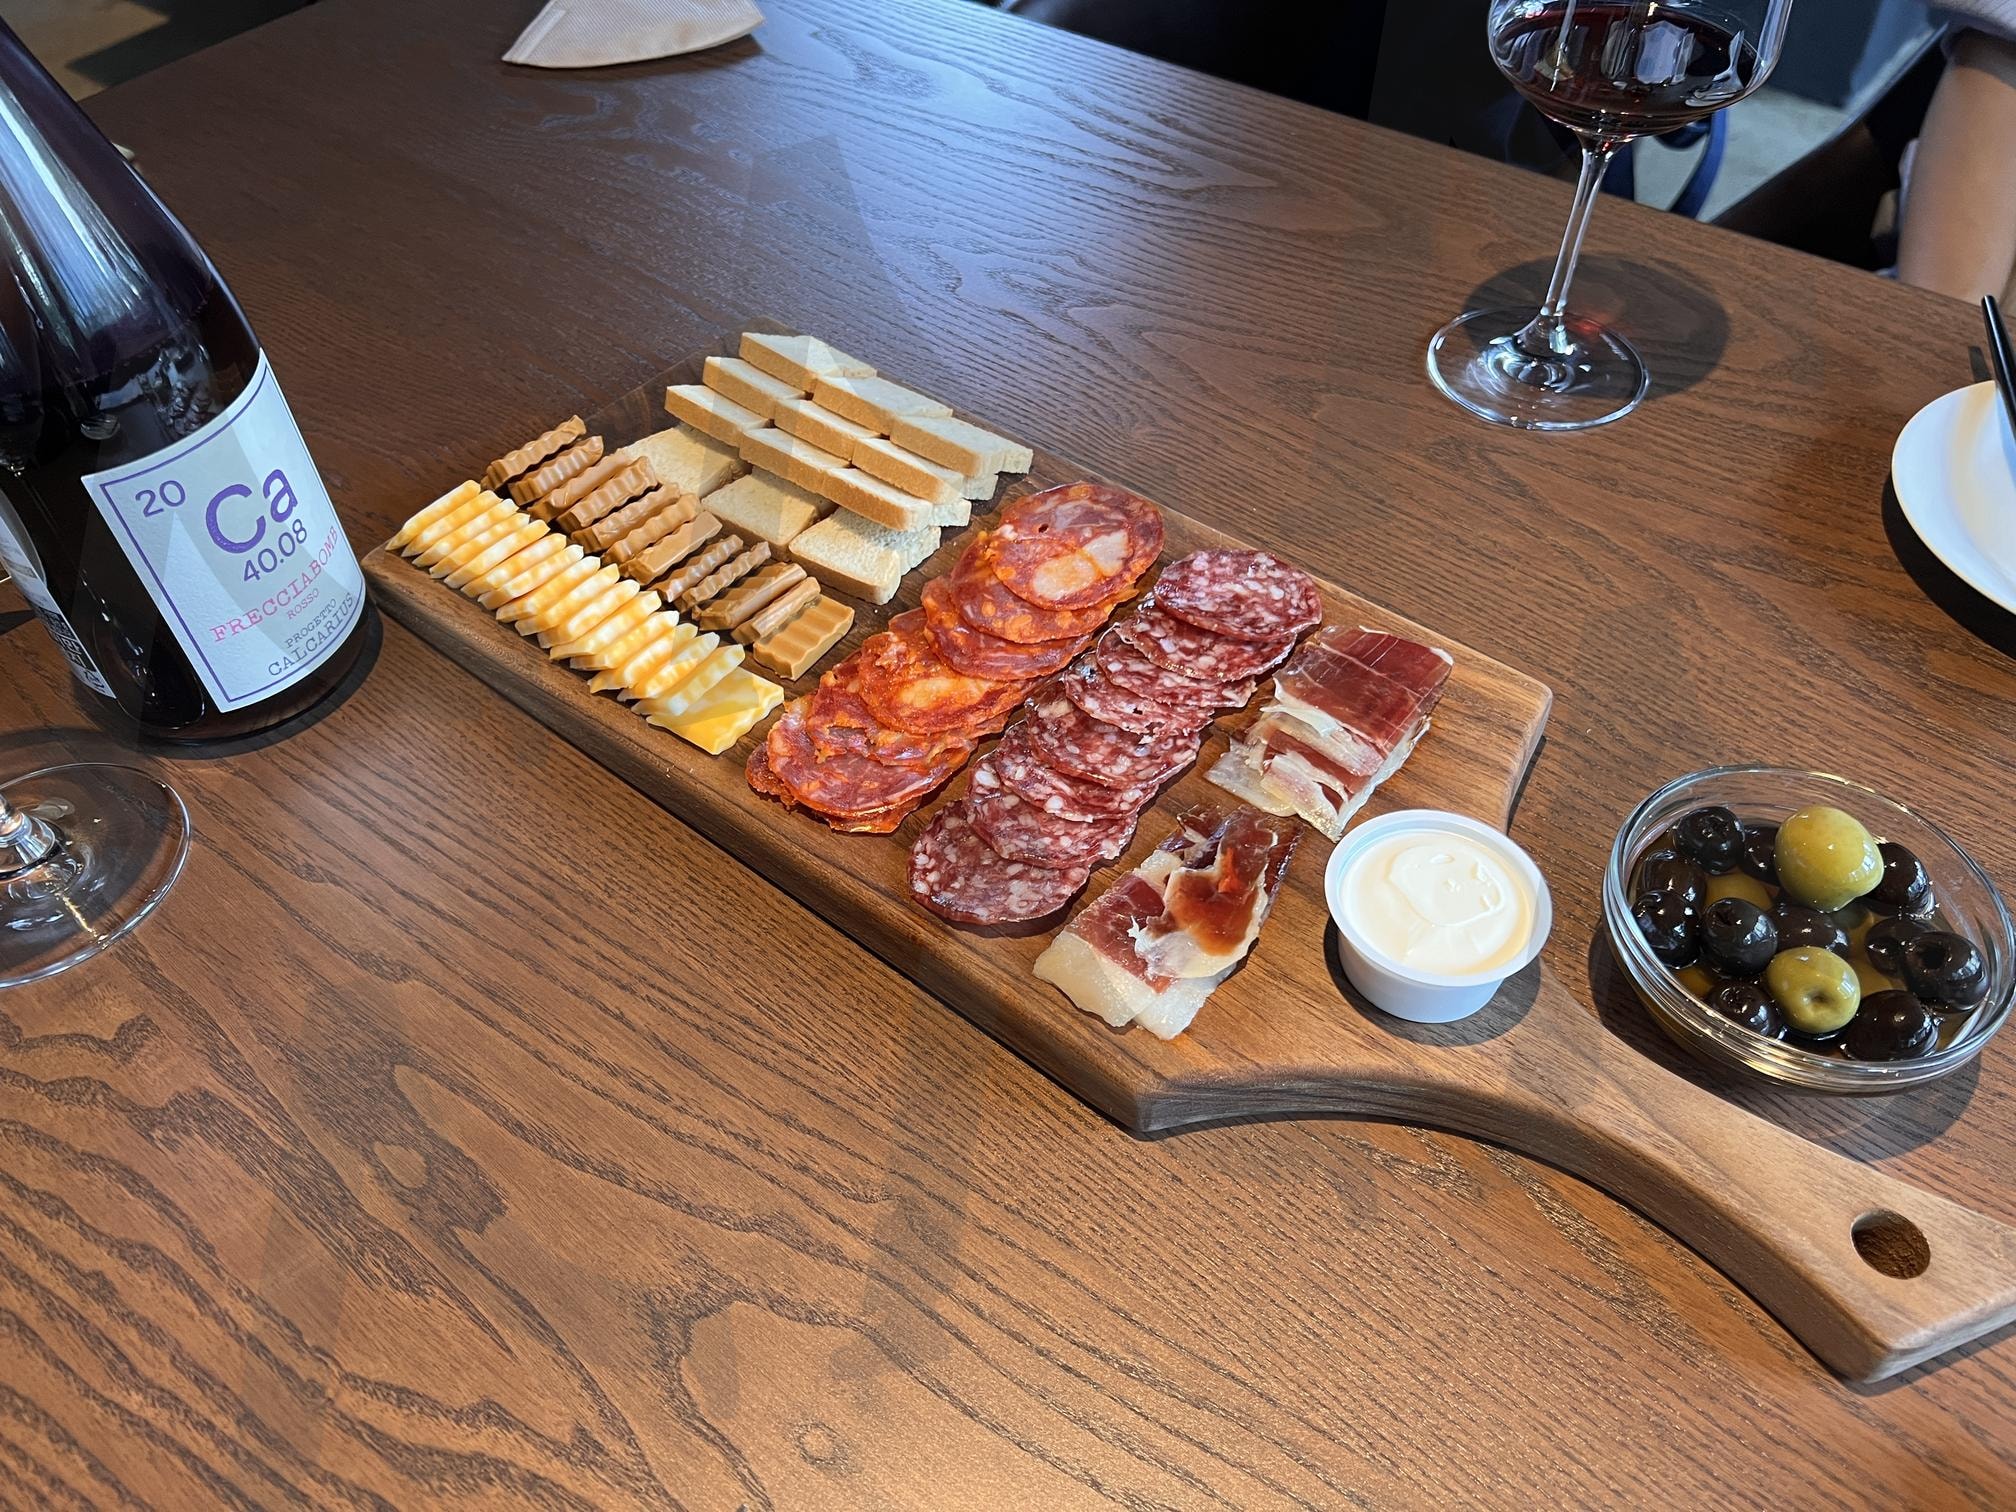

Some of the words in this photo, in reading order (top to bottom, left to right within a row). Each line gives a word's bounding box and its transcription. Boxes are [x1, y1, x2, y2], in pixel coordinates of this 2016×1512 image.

[135, 480, 186, 517] 20
[205, 469, 298, 554] Ca
[243, 518, 308, 583] 40.08
[210, 525, 339, 642] FRECCIABOMB
[287, 588, 320, 620] ROSSO
[268, 592, 354, 677] CALCARIUS
[285, 598, 337, 649] PROGETTO
